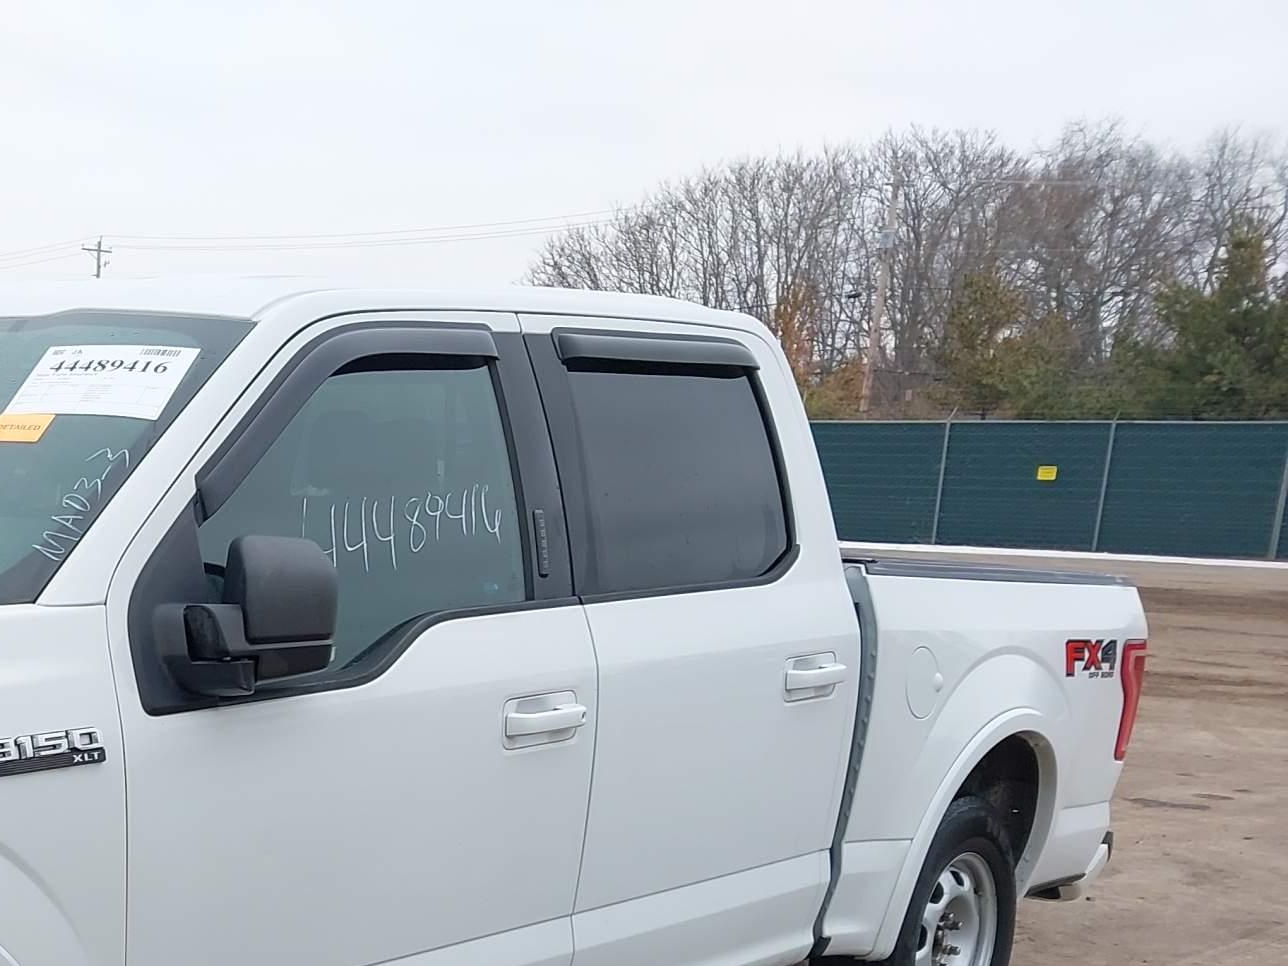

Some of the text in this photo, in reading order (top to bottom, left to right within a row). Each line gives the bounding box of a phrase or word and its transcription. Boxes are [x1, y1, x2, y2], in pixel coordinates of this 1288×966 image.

[50, 359, 173, 374] 44489416
[1065, 639, 1118, 677] FX4
[73, 751, 101, 763] XLT
